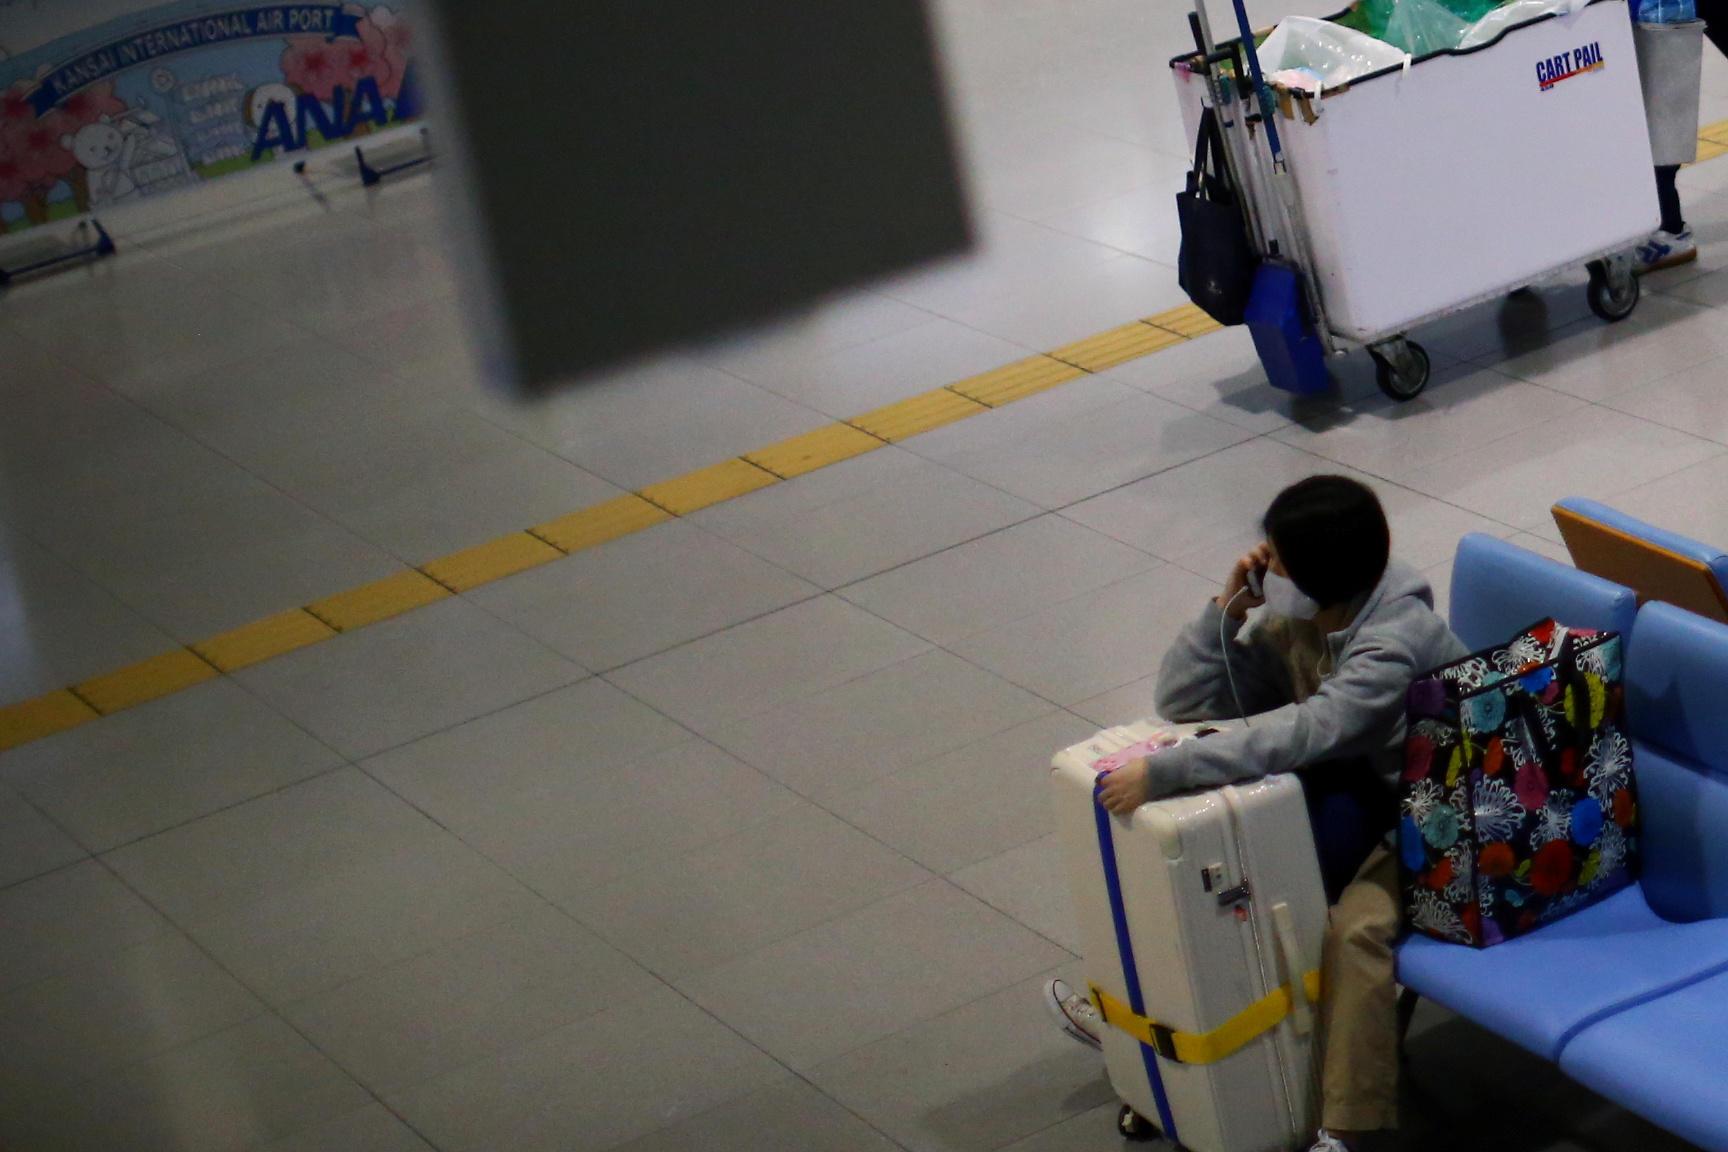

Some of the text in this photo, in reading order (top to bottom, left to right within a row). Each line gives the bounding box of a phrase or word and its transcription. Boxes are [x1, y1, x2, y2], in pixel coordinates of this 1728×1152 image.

[53, 7, 334, 95] KANSAI INTERNATIONAL AIR PORT
[1536, 41, 1604, 83] CART PAIL
[250, 77, 387, 162] ANA
